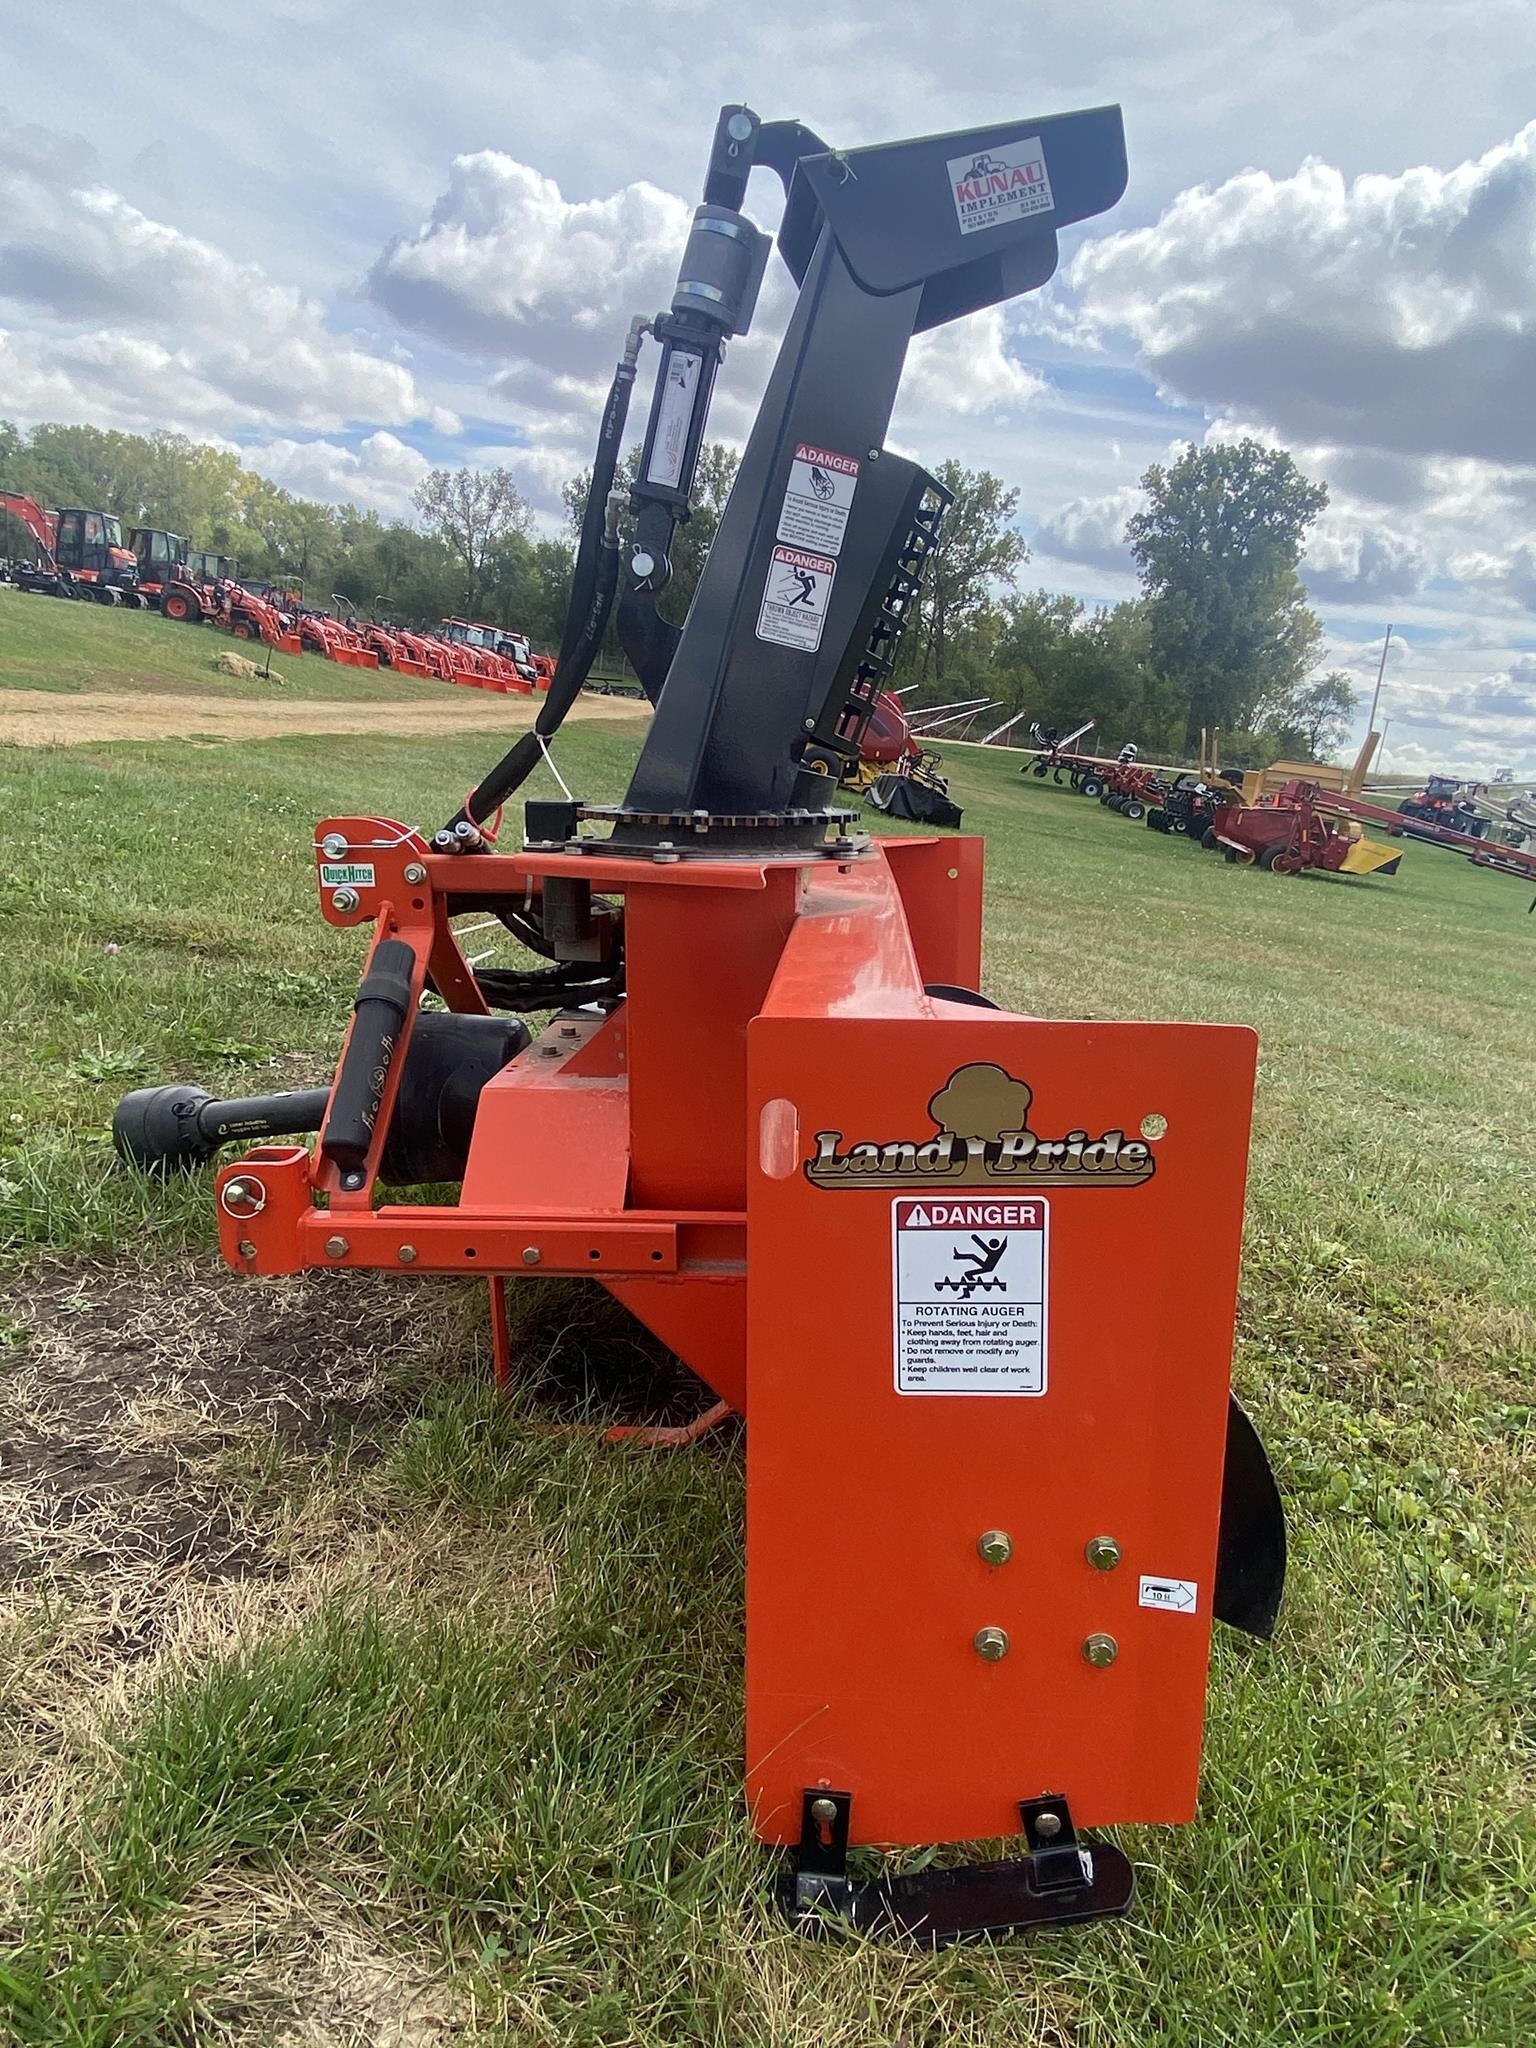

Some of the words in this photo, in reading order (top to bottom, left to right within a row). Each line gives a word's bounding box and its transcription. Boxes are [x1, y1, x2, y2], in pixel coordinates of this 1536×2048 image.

[956, 163, 1044, 203] KUNAU
[960, 183, 1046, 214] IMPLEMENT
[806, 449, 859, 474] DANGER
[785, 550, 833, 573] DANGER
[811, 1132, 956, 1175] Land
[993, 1130, 1148, 1174] Pride
[931, 1206, 1036, 1225] DANGER
[916, 1307, 978, 1316] ROTATING
[981, 1307, 1025, 1316] AUGER
[977, 1320, 1000, 1329] Injury
[907, 1339, 939, 1347] clothing
[983, 1339, 1013, 1347] rotating
[976, 1348, 1003, 1356] modify
[907, 1366, 927, 1374] Keep
[1153, 1592, 1162, 1600] 10
